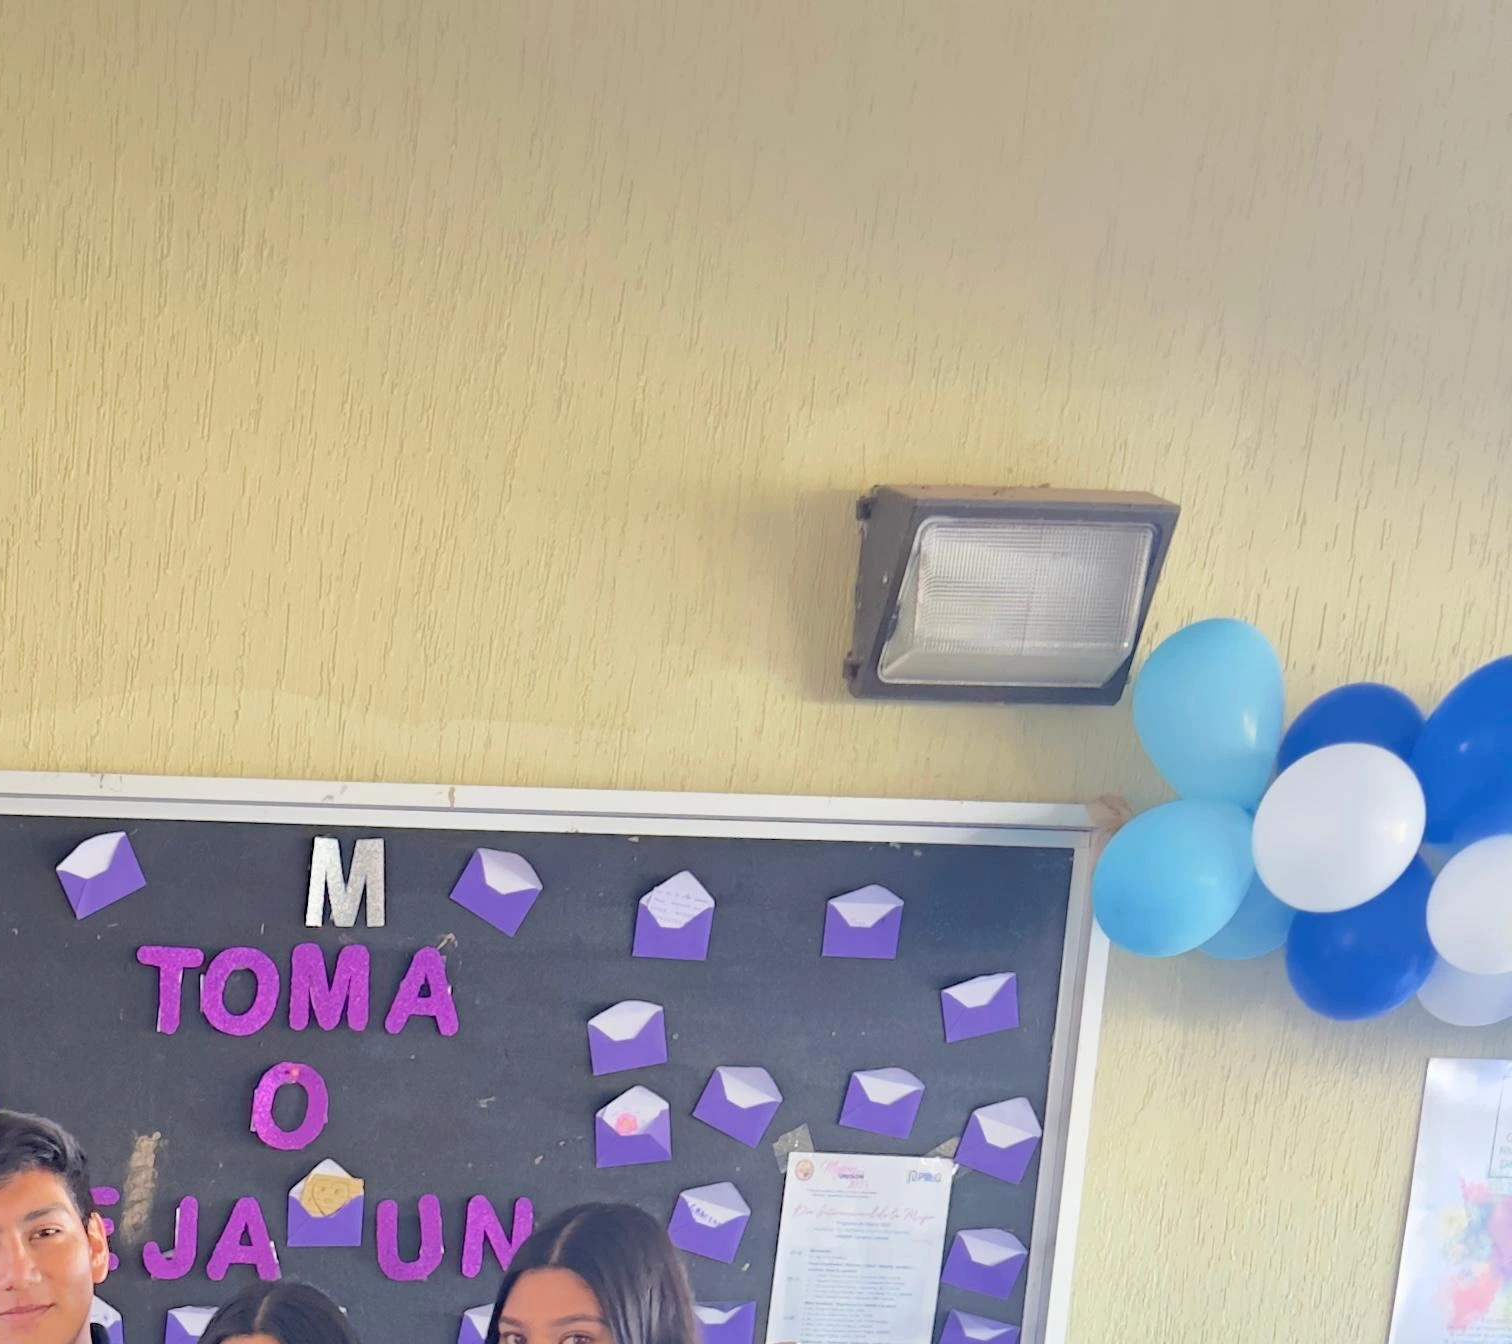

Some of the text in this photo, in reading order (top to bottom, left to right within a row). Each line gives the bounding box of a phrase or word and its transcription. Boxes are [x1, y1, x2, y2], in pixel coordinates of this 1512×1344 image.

[305, 836, 385, 927] M
[136, 943, 459, 1037] TOMA
[251, 1061, 329, 1150] O
[376, 1193, 534, 1281] UN
